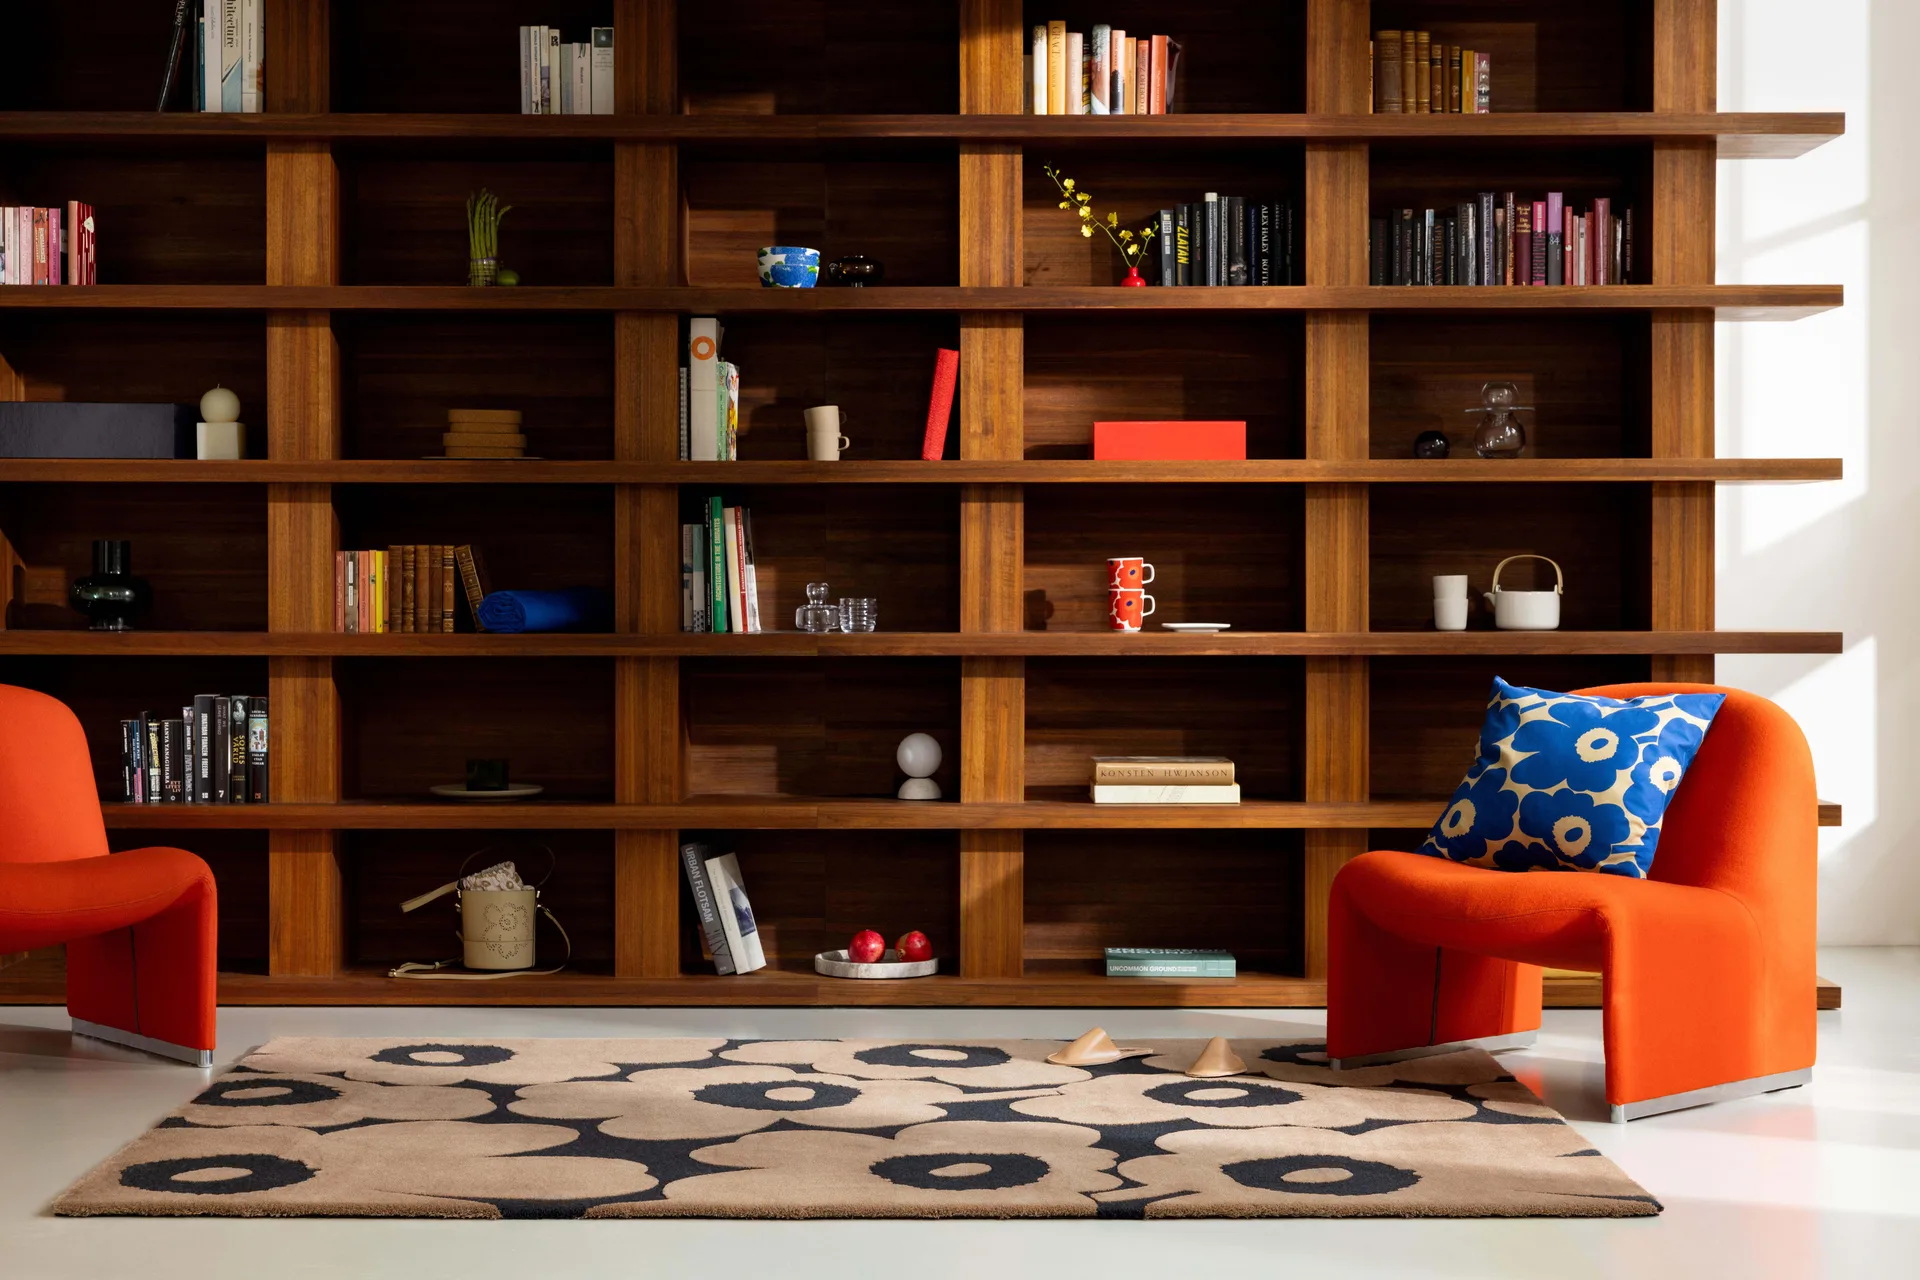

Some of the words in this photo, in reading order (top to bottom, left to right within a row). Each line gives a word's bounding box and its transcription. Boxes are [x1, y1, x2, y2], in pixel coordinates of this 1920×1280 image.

[1261, 204, 1269, 226] ALEX
[1176, 225, 1190, 265] ZLATAN
[1261, 227, 1269, 253] HALEY
[714, 562, 722, 602] ARCHITECTURE
[201, 713, 209, 736] JONATHAN
[201, 736, 209, 757] FRANZEN
[231, 736, 239, 764] VÄRLD
[201, 757, 209, 779] FREEDOM
[1101, 769, 1154, 777] KONSTEN
[685, 847, 701, 880] URBAN
[694, 878, 714, 923] FLOTSAM
